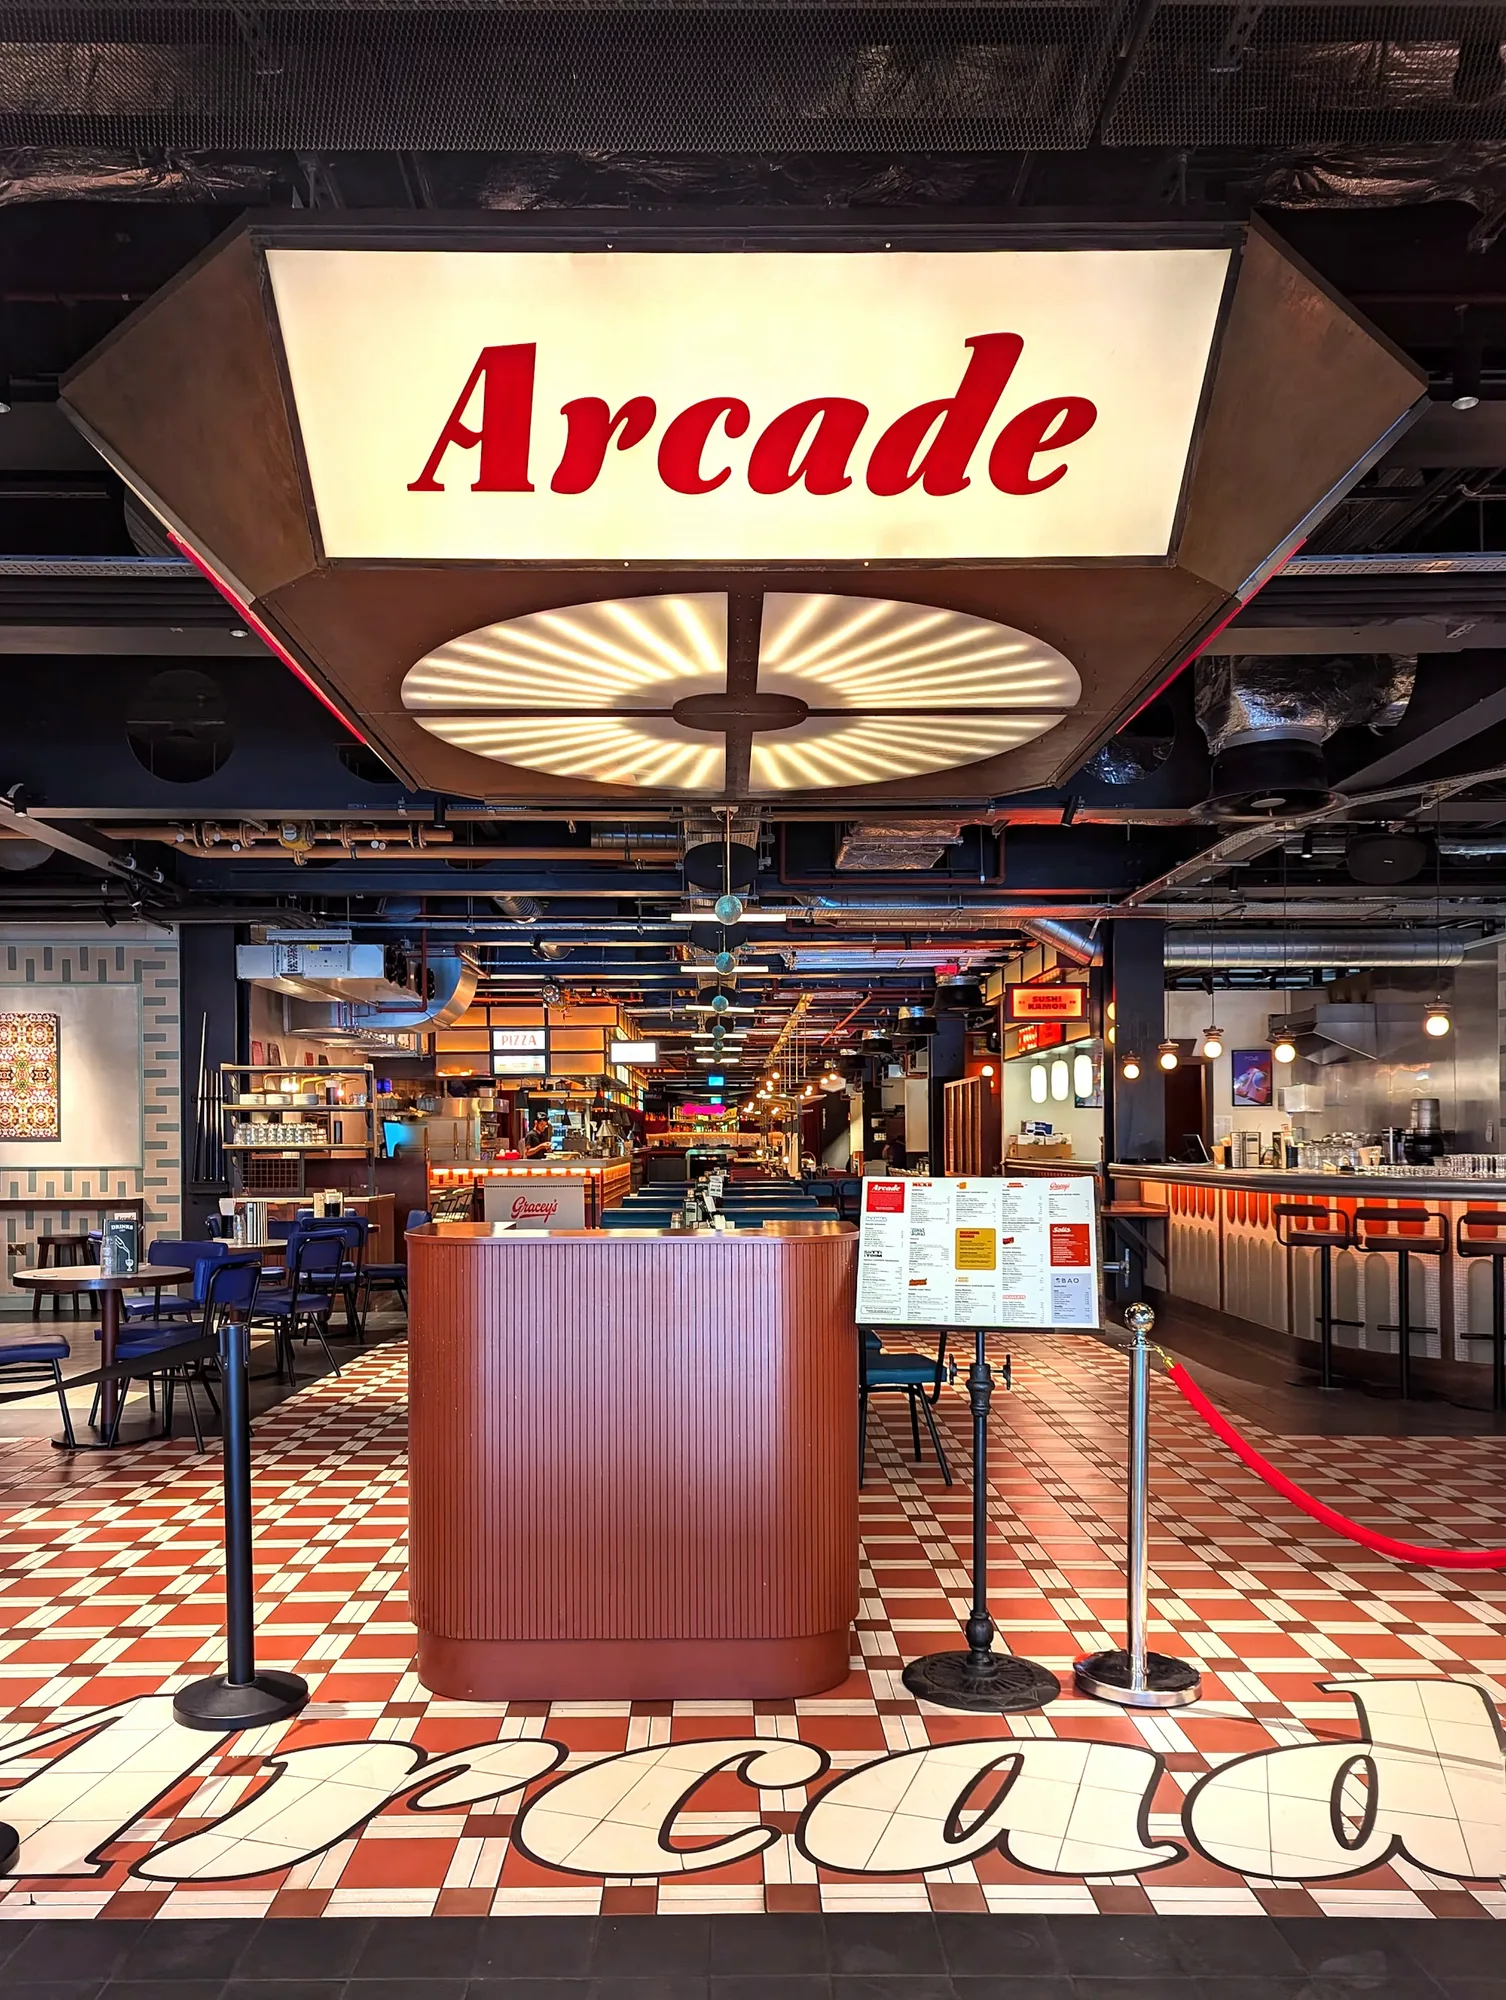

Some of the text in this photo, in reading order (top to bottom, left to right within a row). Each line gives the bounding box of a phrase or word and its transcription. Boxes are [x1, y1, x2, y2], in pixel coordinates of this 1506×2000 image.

[407, 332, 1098, 496] Arcade
[501, 1034, 537, 1046] PIZZA
[871, 1184, 901, 1192] Arcade
[511, 1196, 558, 1223] Gracey's
